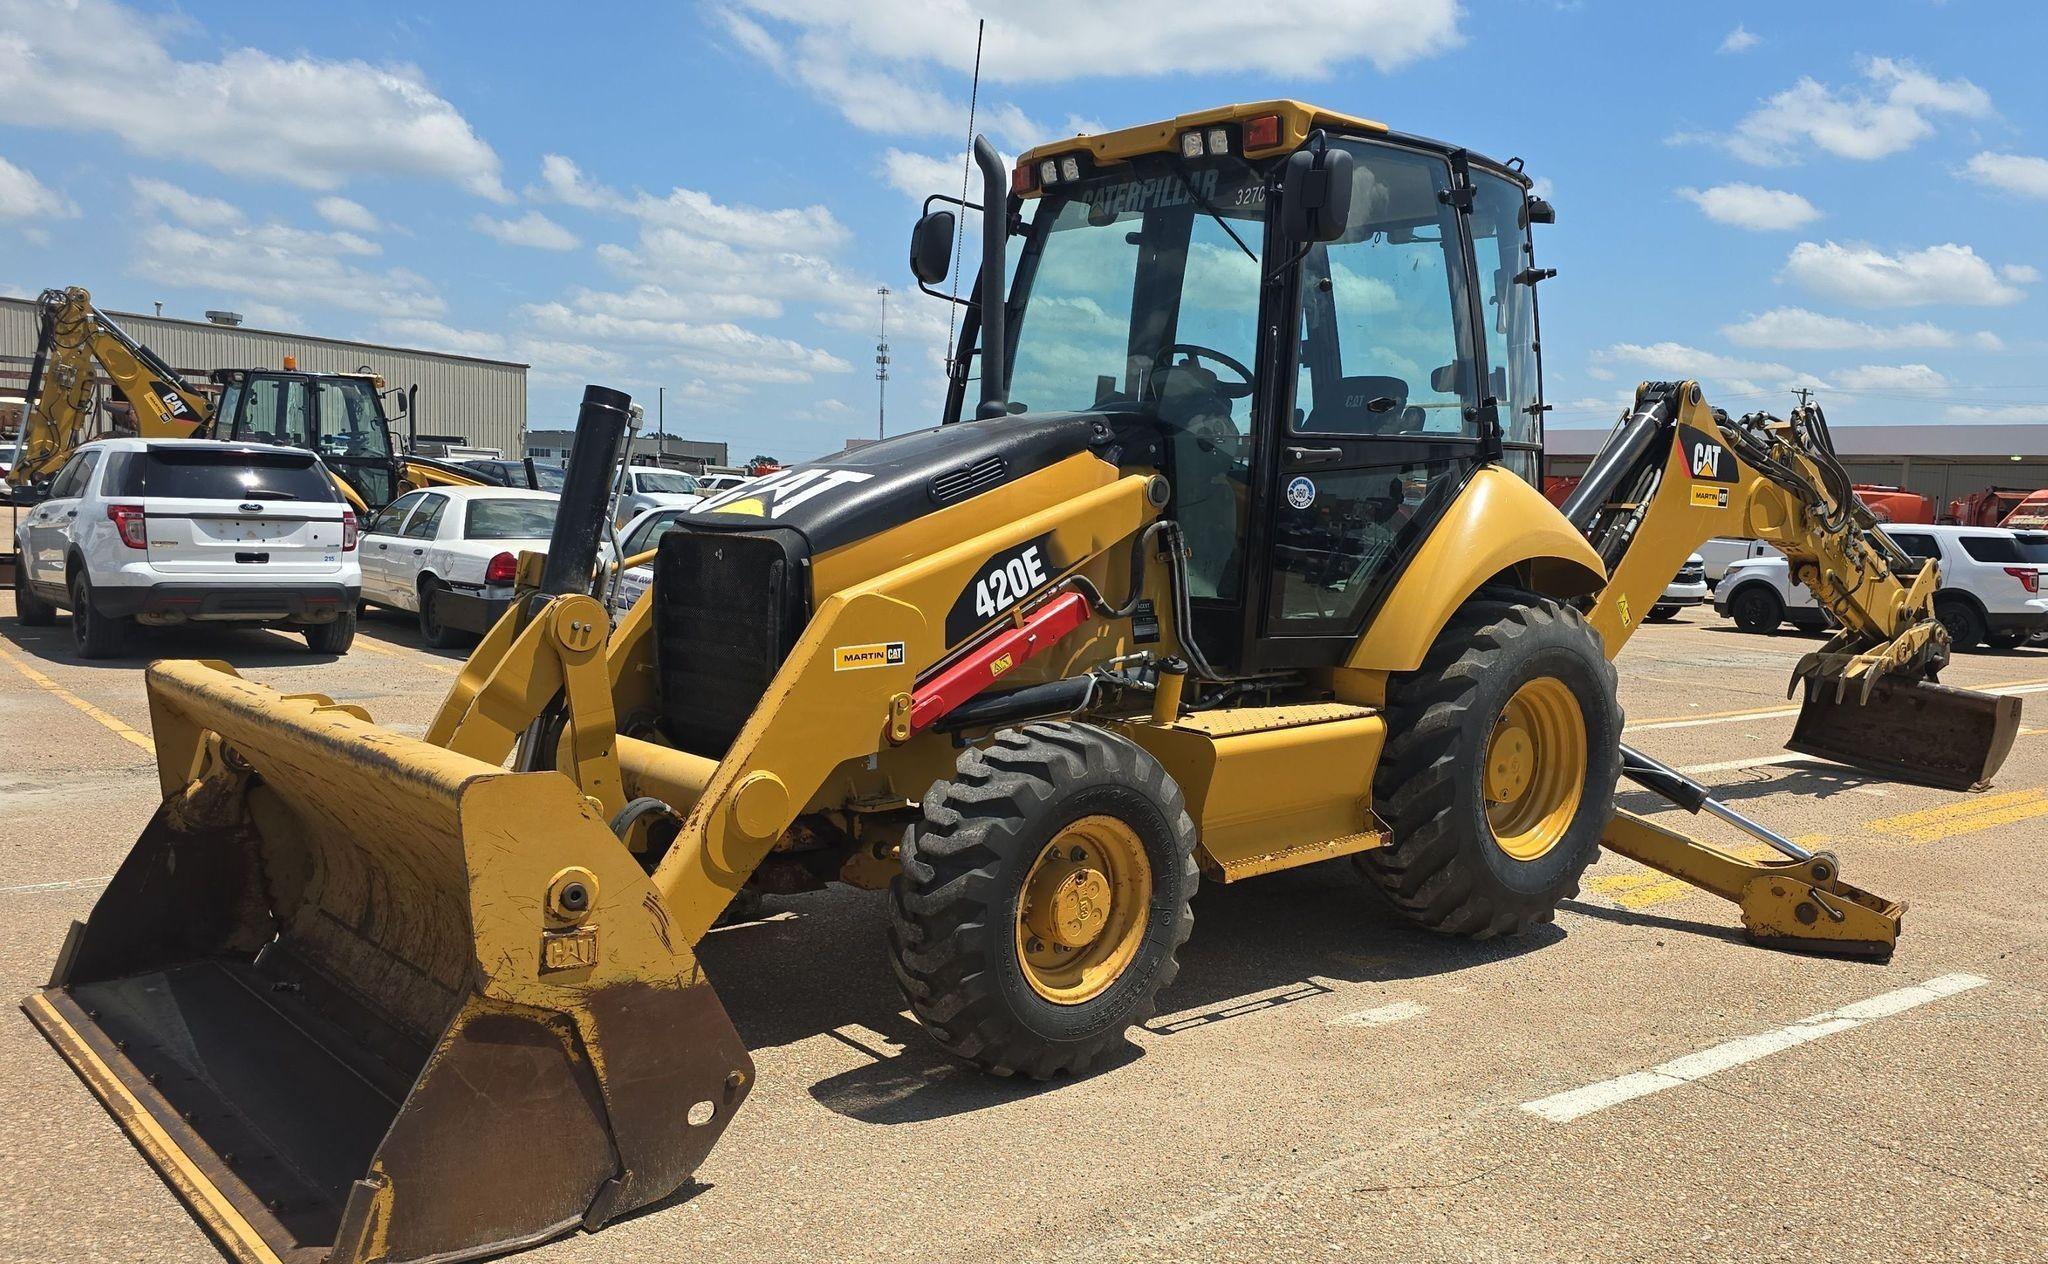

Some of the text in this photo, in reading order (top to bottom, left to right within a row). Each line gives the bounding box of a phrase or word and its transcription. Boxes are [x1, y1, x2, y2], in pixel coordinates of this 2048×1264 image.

[163, 392, 188, 416] CAT
[1345, 394, 1365, 408] CAT
[1693, 443, 1722, 478] CAT
[689, 469, 875, 519] CAT
[1695, 492, 1718, 501] MARTIN
[976, 545, 1047, 618] 420E
[844, 648, 902, 662] MARTIN CAT
[546, 937, 595, 968] CAT
